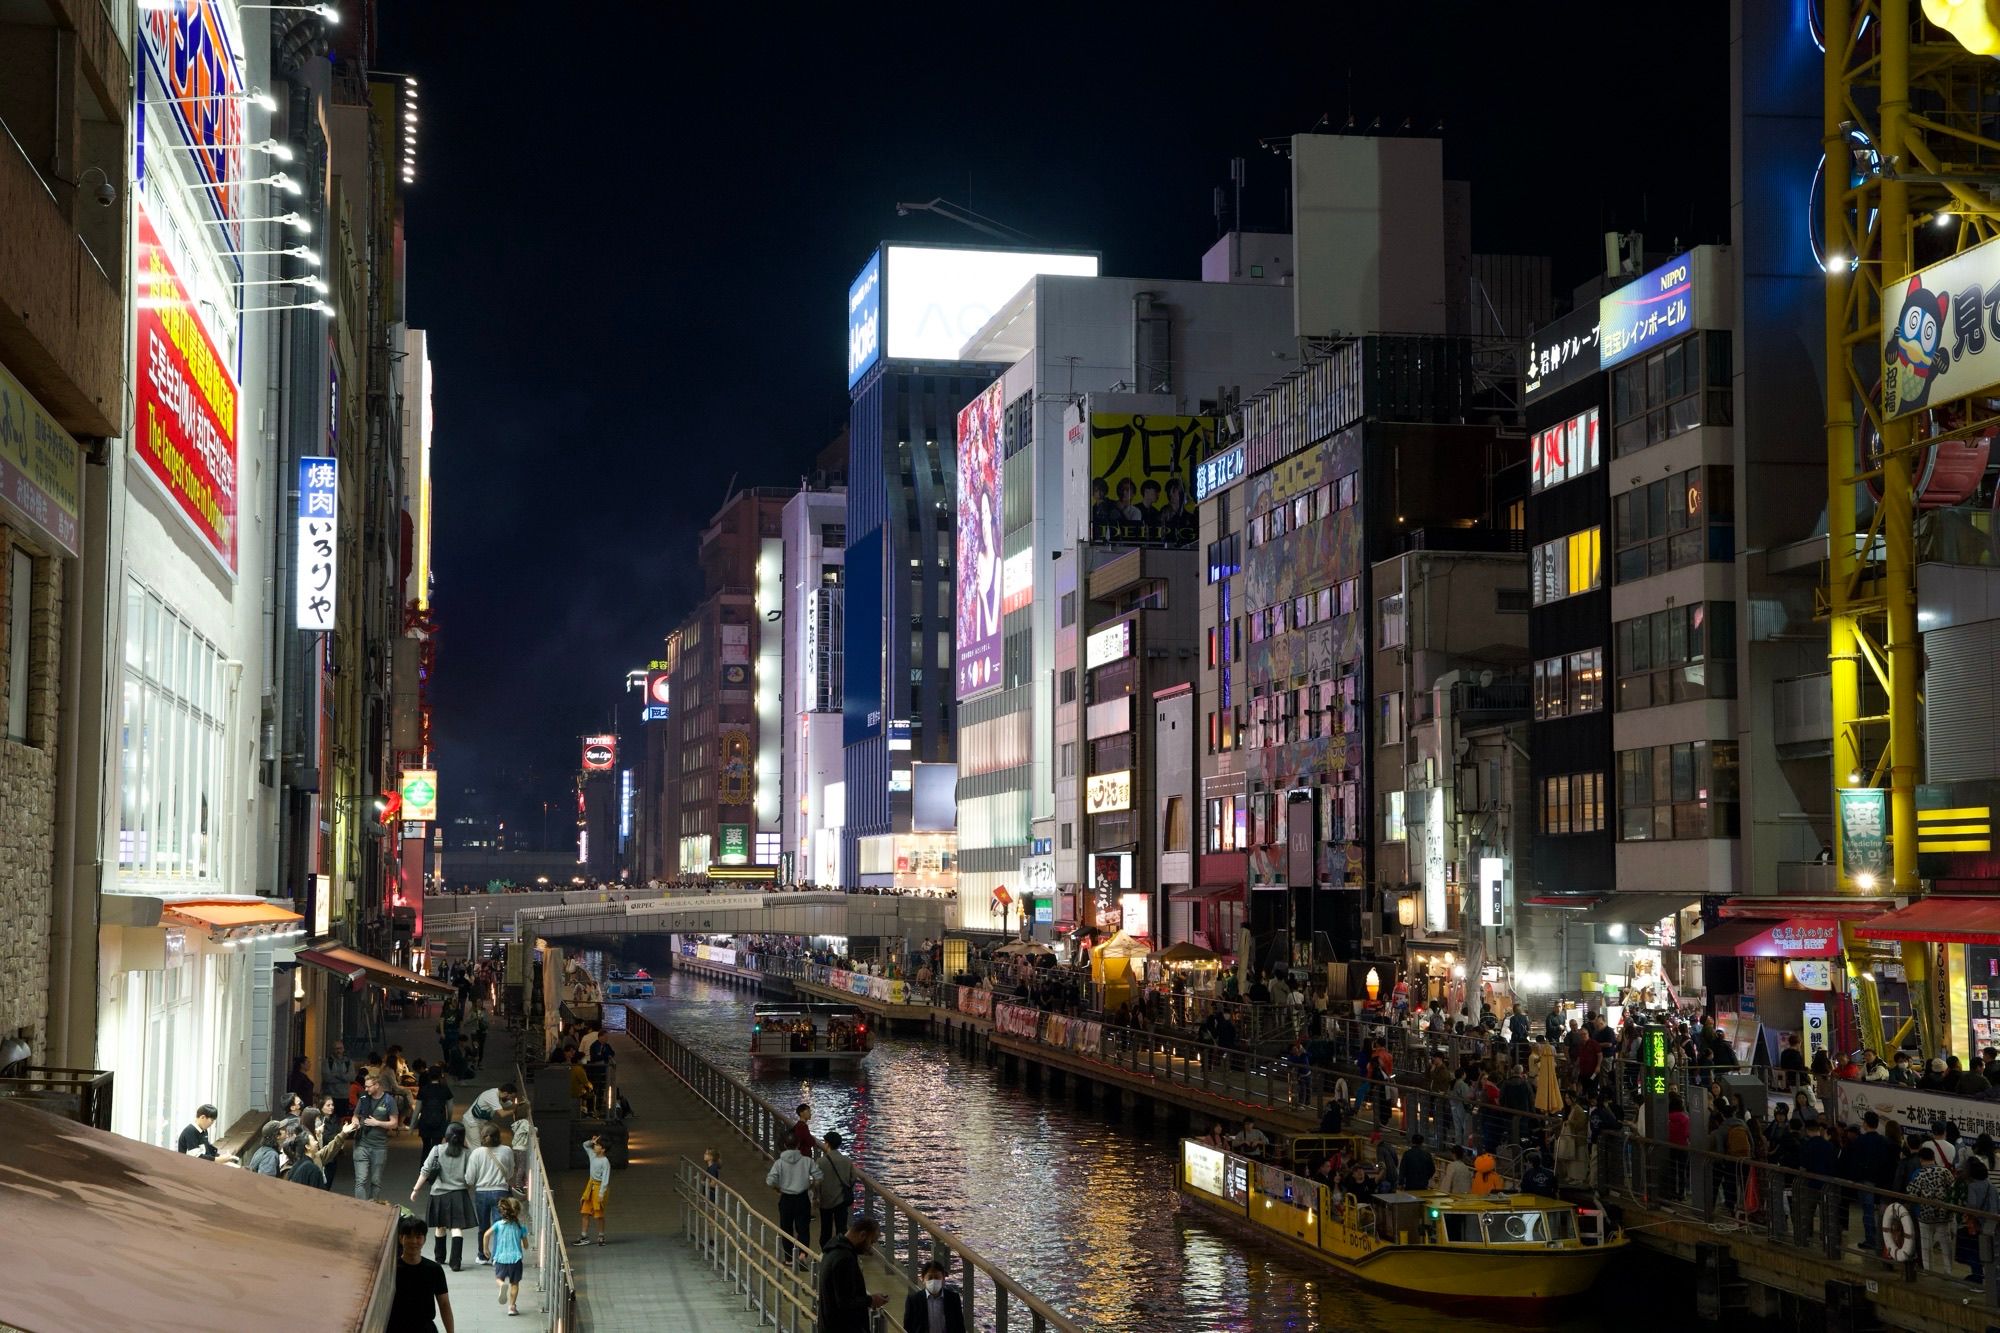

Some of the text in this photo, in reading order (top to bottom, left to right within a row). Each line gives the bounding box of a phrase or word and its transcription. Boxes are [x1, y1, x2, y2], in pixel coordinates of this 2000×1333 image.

[1660, 265, 1687, 292] NIPPO
[850, 306, 879, 374] Haier
[148, 401, 161, 459] The
[162, 420, 185, 489] largest
[185, 463, 200, 509] store
[1272, 444, 1323, 501] 2025
[308, 463, 335, 515] 焼肉
[308, 522, 333, 624] いろりや
[586, 737, 612, 745] HOTEL
[726, 828, 742, 845] 薬
[1845, 801, 1881, 838] 薬
